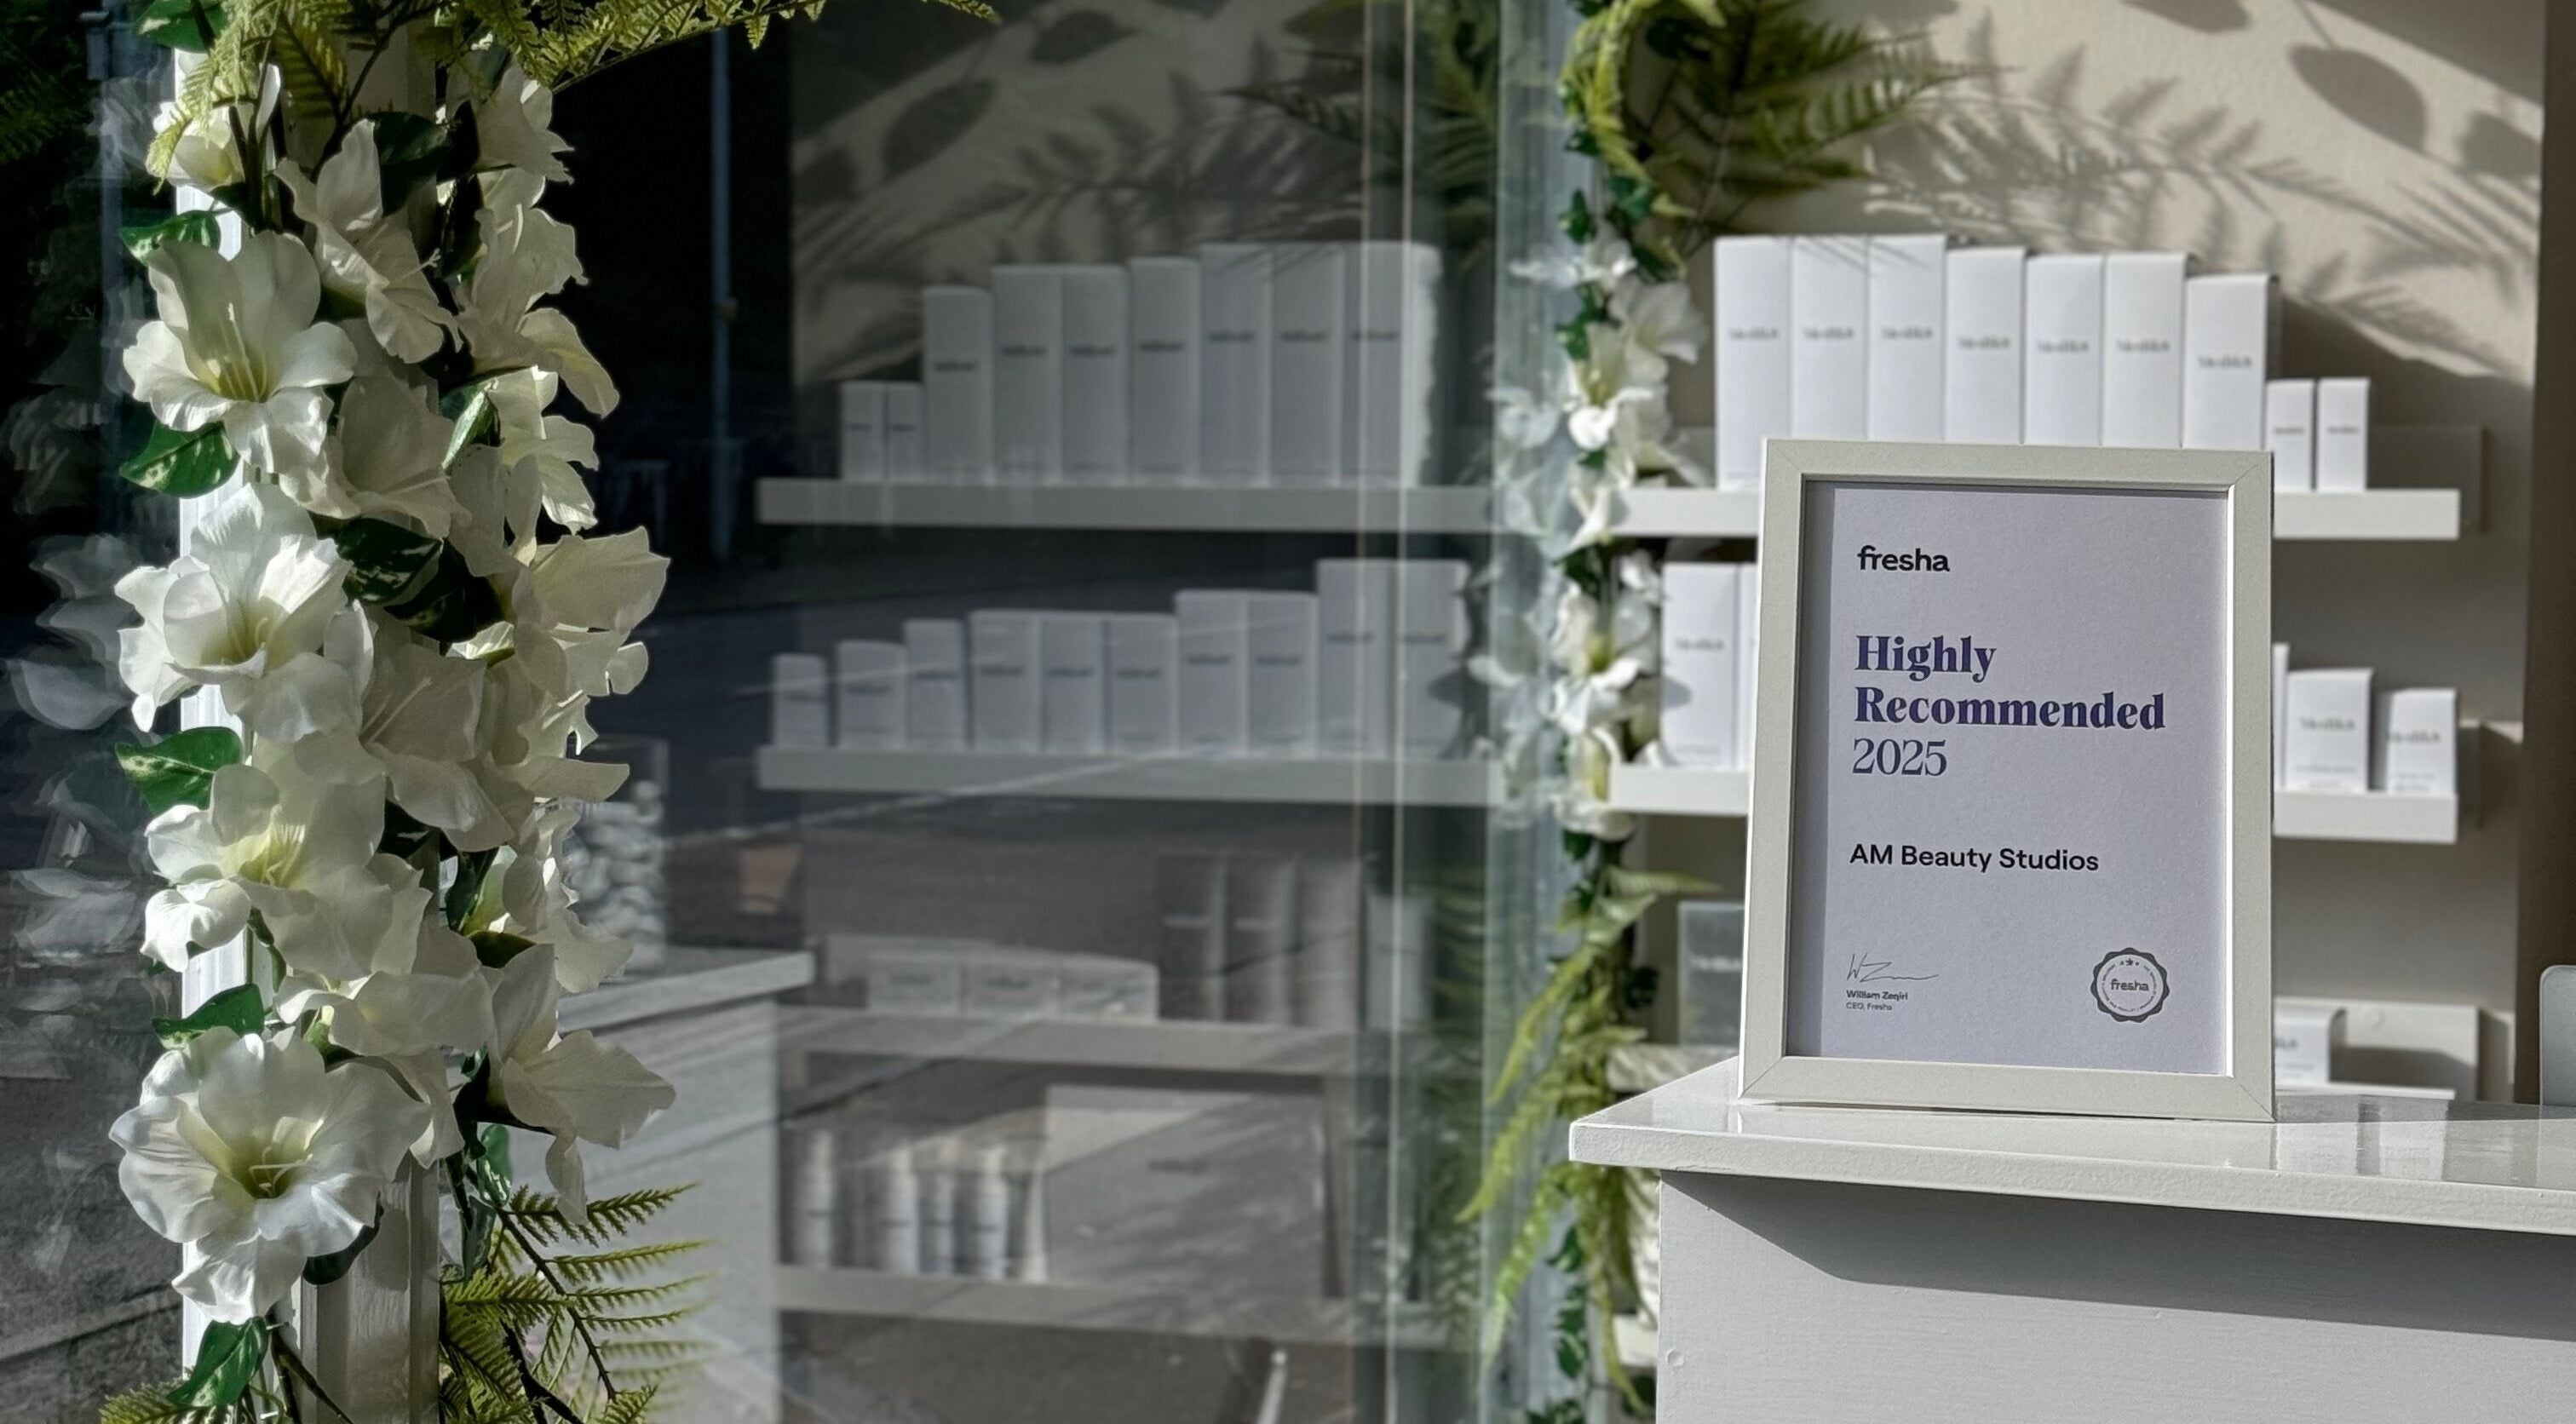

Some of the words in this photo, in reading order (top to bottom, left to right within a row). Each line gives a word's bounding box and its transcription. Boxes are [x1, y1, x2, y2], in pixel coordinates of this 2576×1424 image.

[1857, 545, 1950, 571] fresha
[1855, 635, 1997, 683] Highly
[1854, 687, 2165, 730] Recommended
[1852, 738, 1946, 776] 2025
[1850, 844, 1892, 864] AM
[1901, 845, 1992, 874] Beauty
[1999, 848, 2099, 871] Studios
[1846, 990, 1880, 999] William
[2110, 978, 2149, 991] fresha
[1866, 1002, 1893, 1011] Fresha
